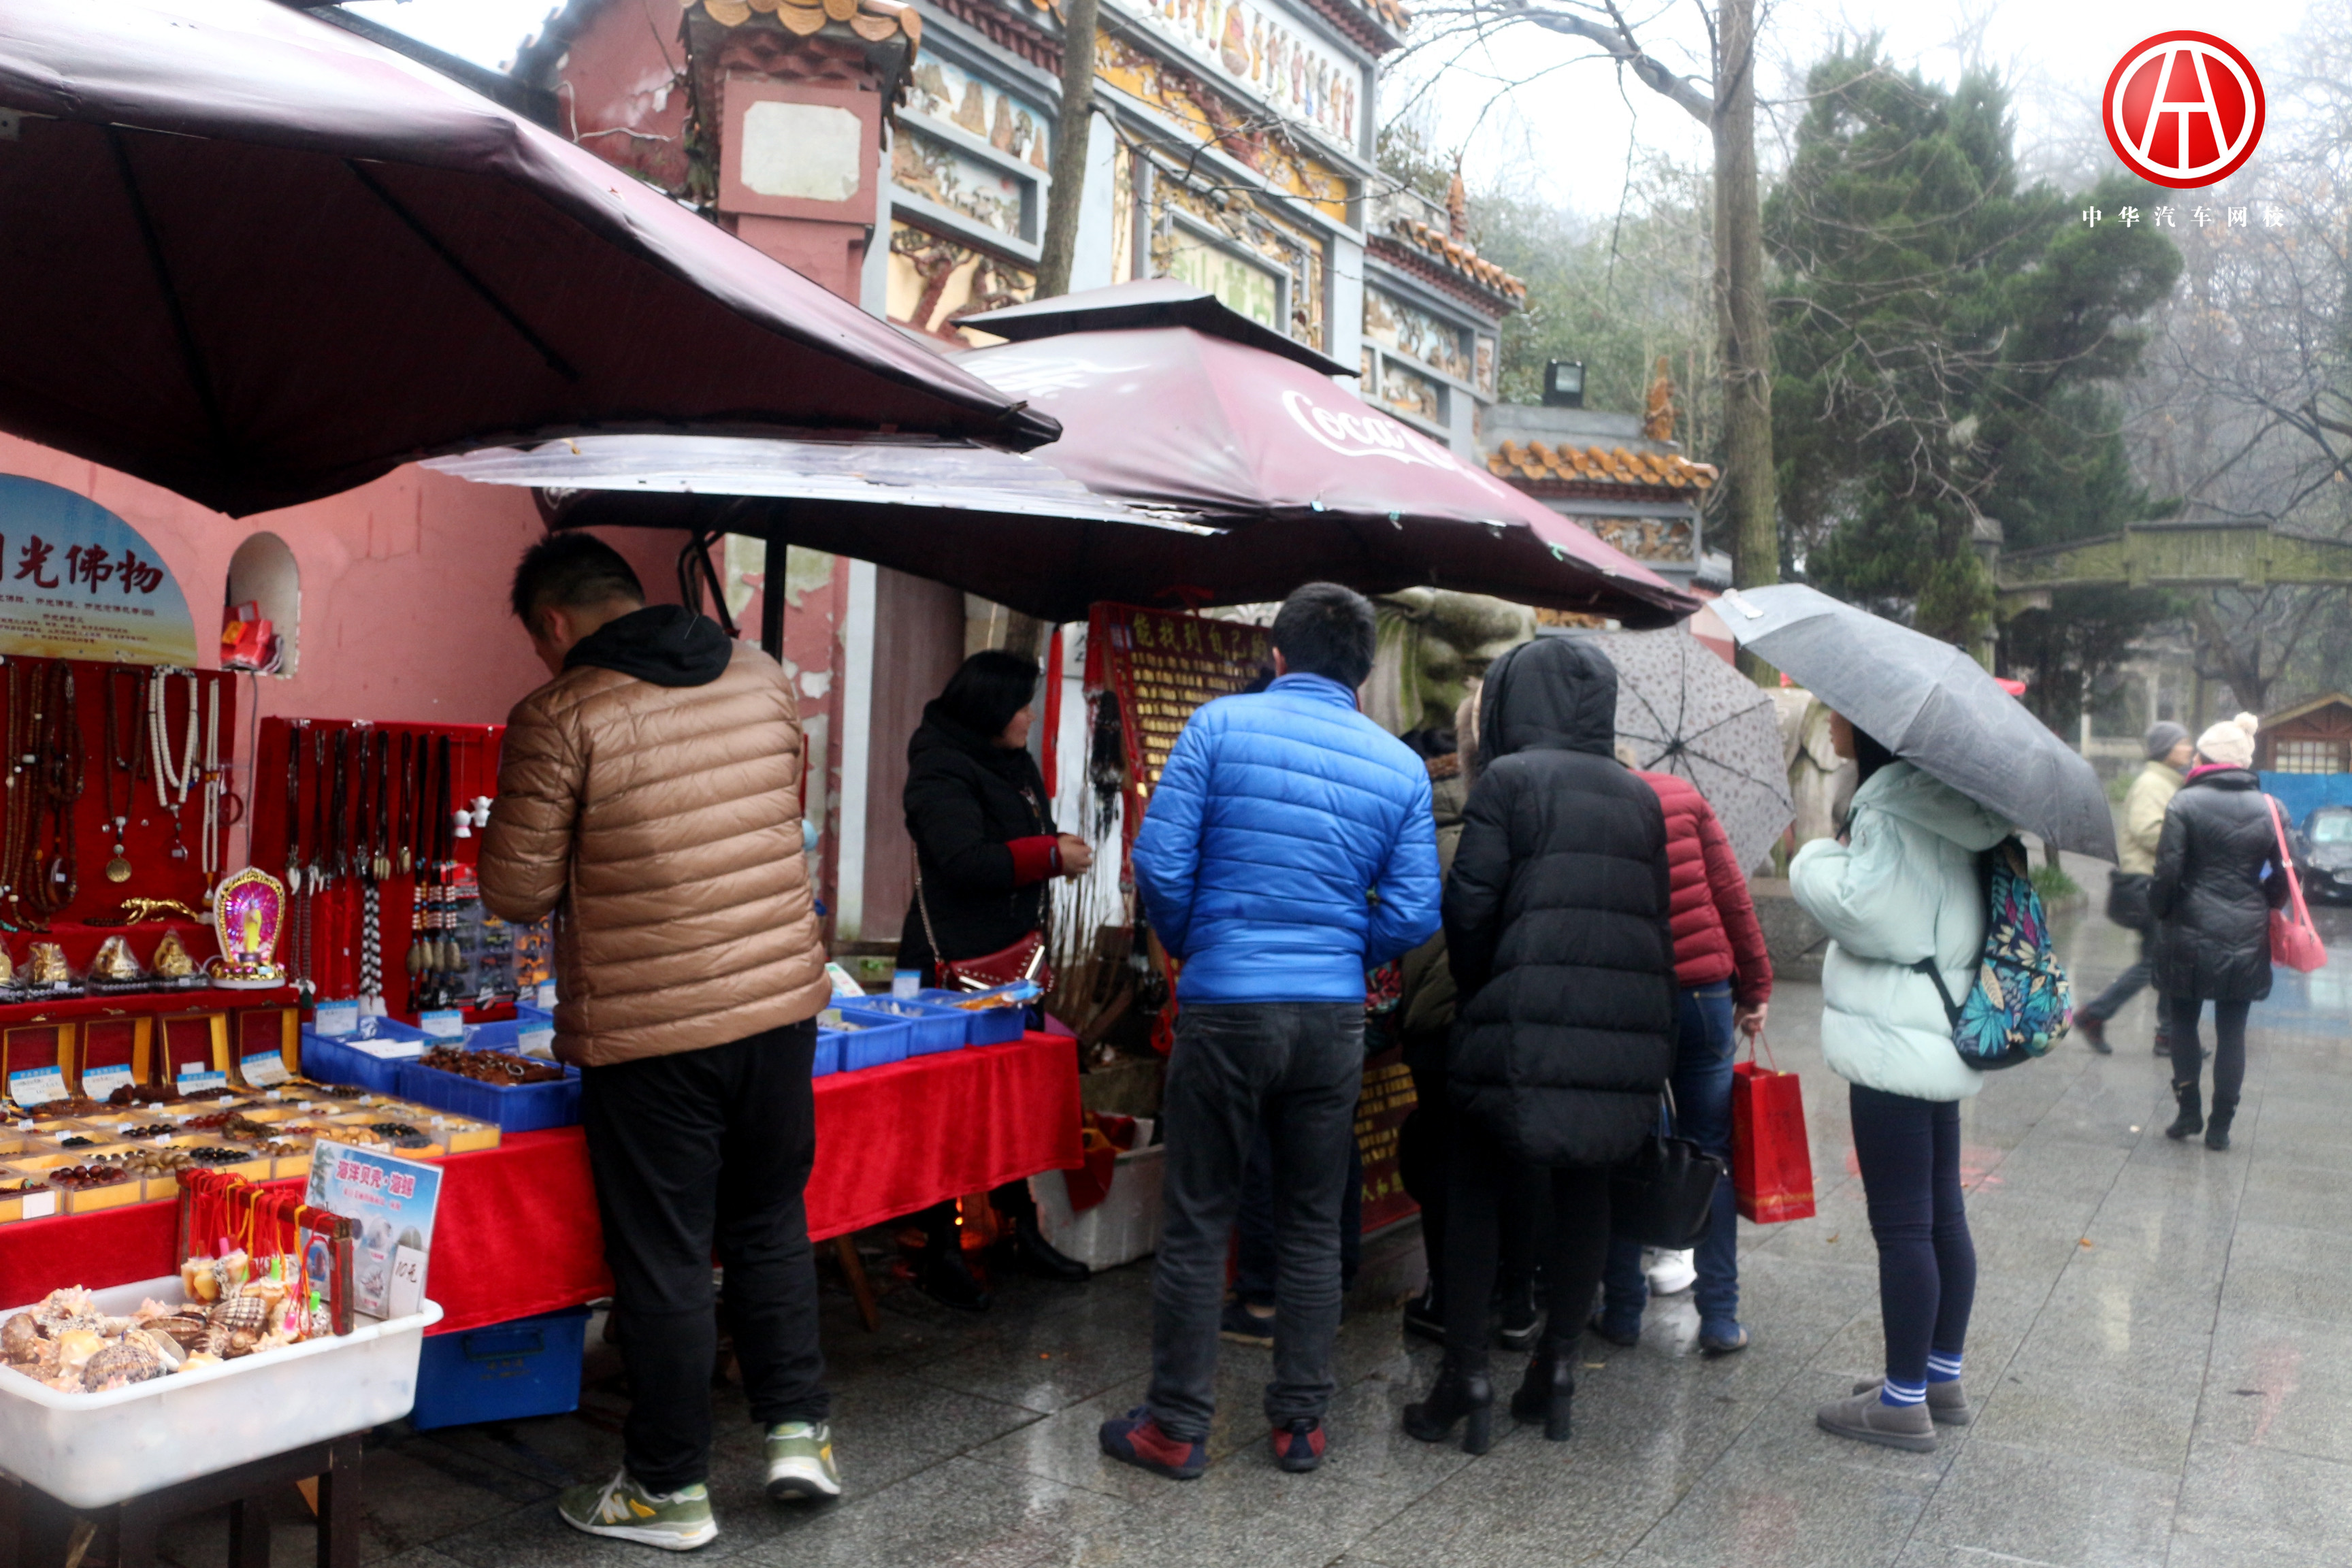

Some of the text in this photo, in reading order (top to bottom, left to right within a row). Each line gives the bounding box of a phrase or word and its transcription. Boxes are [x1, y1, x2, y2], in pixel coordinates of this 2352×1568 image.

[1282, 390, 1435, 467] Coca
[0, 533, 163, 594] 光佛物
